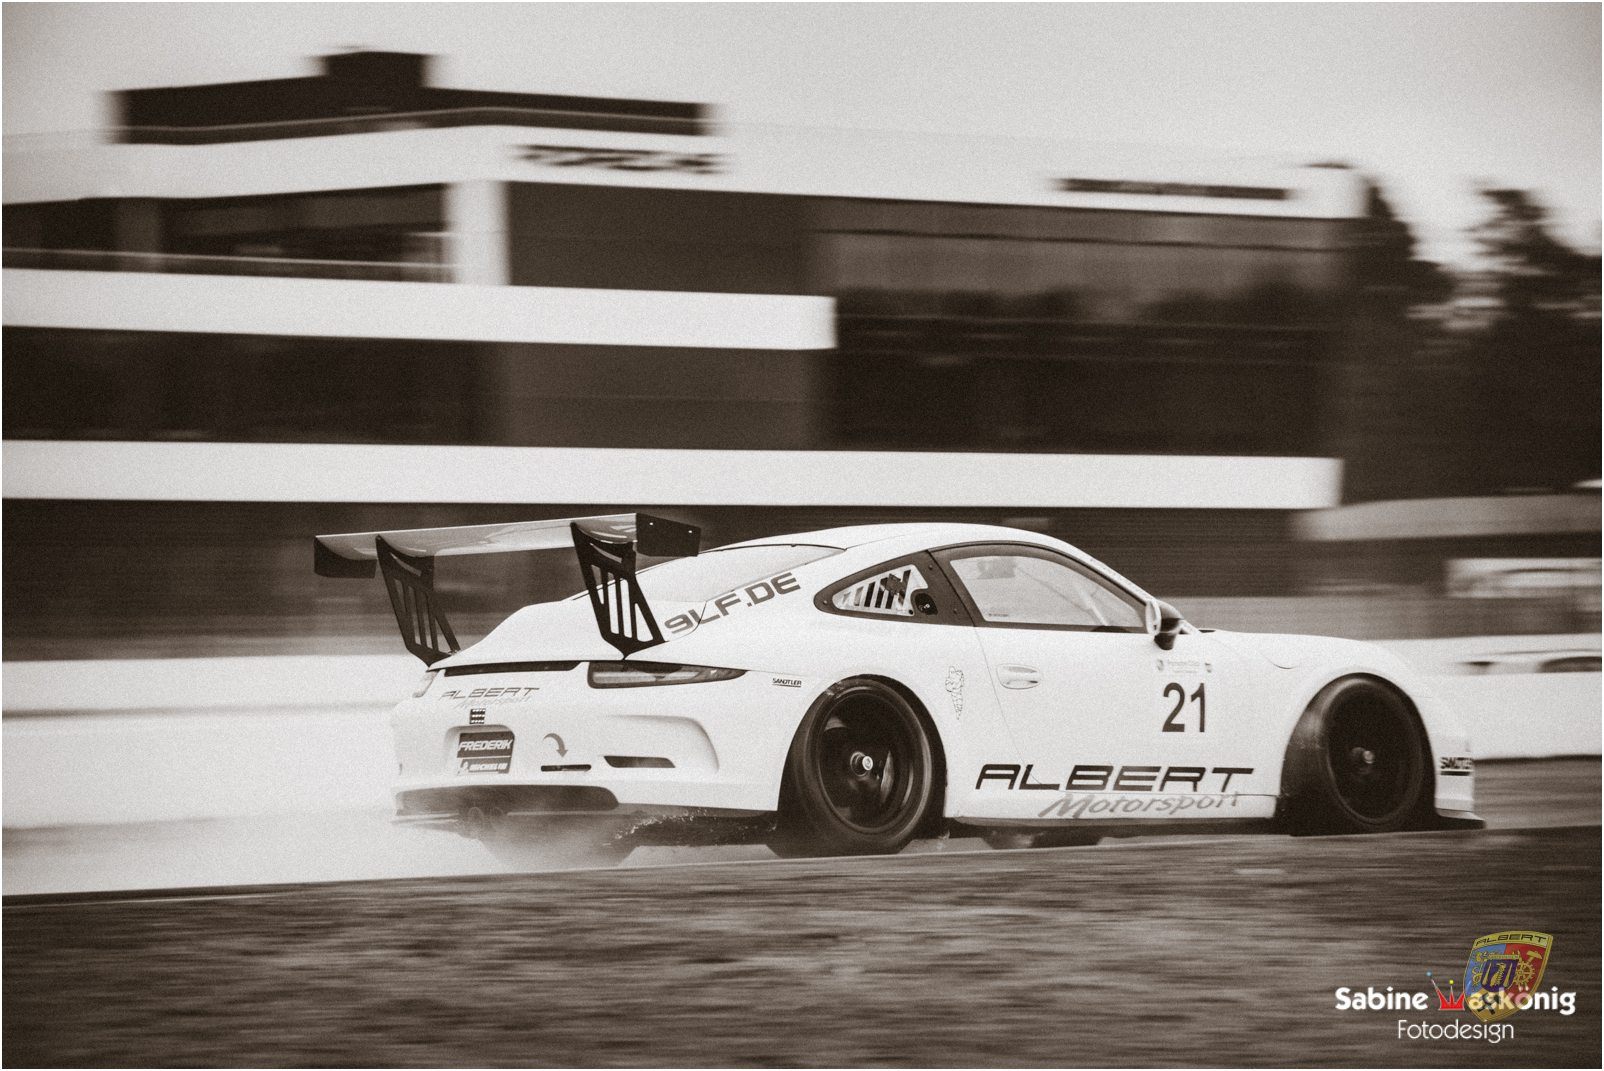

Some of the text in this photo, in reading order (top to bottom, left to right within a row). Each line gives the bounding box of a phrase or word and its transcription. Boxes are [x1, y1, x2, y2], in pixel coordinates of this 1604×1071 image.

[664, 571, 801, 634] 9LF.DE
[438, 687, 540, 701] ALBERT
[772, 677, 802, 686] SANDTLER
[1162, 682, 1206, 732] 21
[459, 739, 513, 751] FREDERIK
[975, 763, 1255, 793] ALBERT
[1037, 791, 1239, 819] Motorsport
